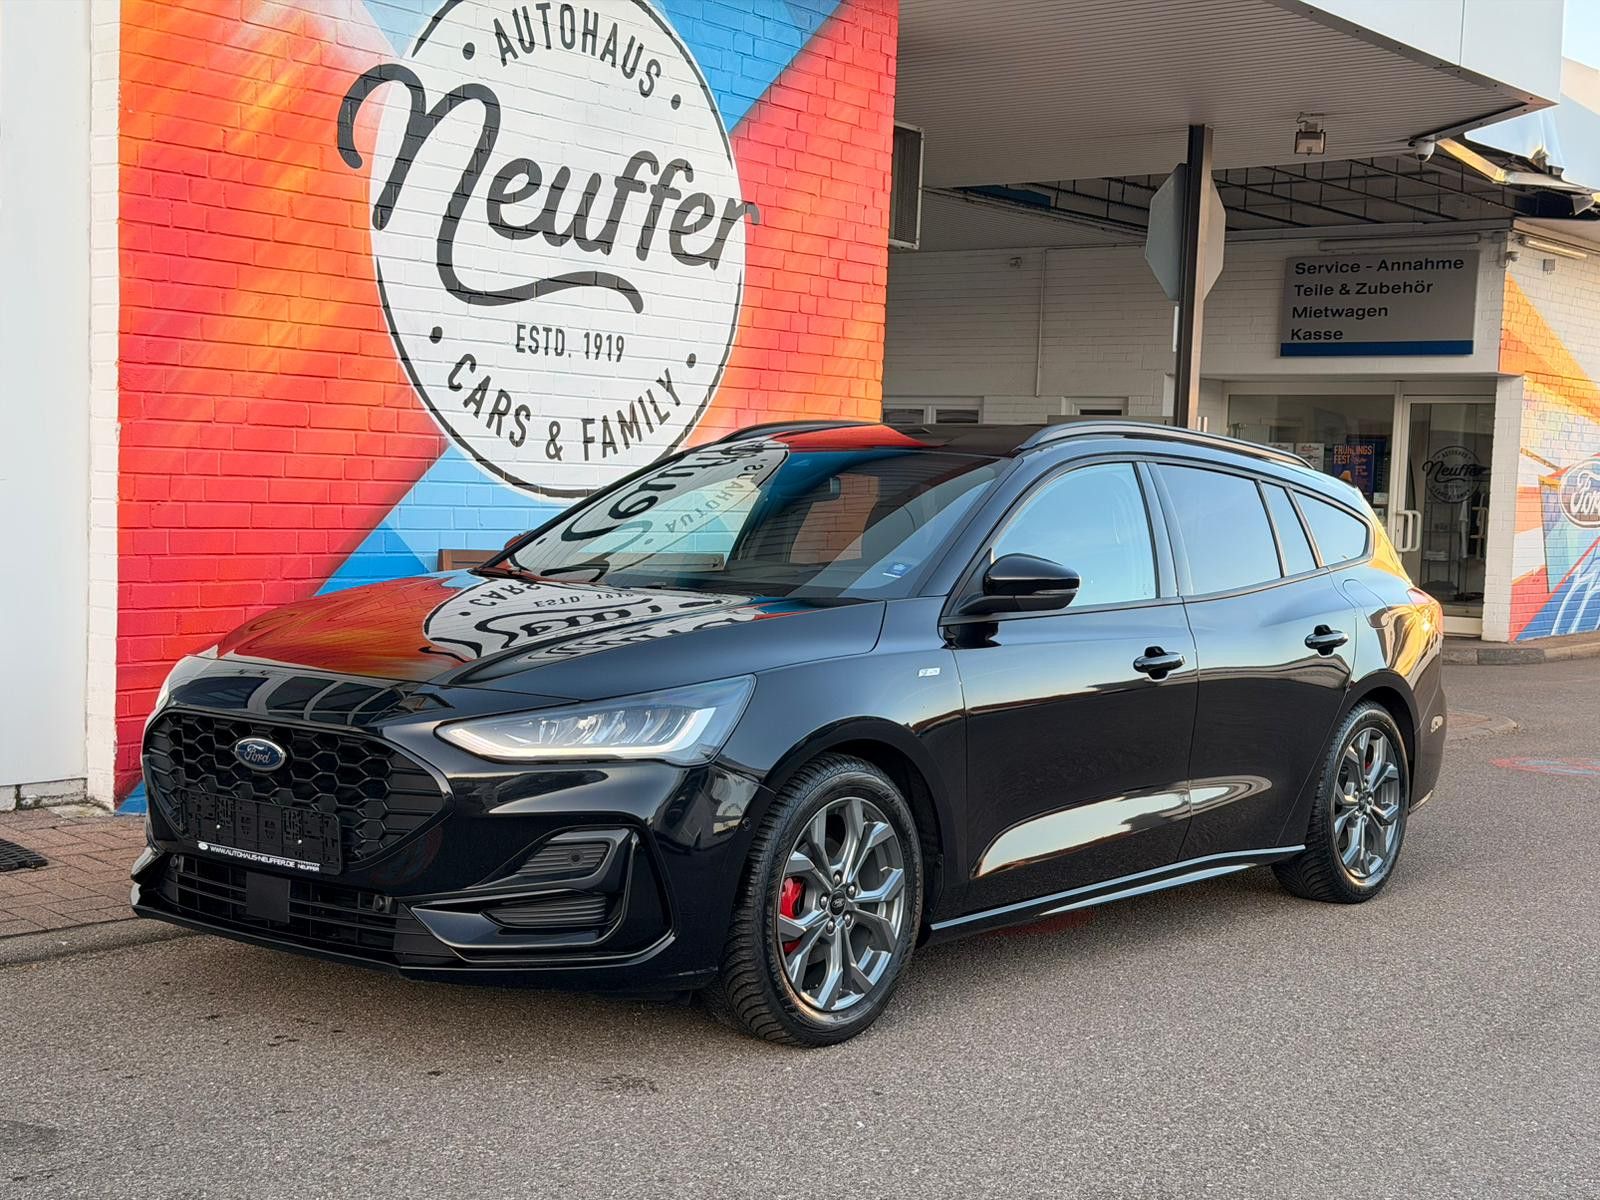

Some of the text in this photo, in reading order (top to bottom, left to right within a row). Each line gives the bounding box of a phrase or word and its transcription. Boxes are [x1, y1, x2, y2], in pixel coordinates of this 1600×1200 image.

[493, 3, 661, 98] AUTOHAUS
[337, 64, 760, 314] Neuffer
[1295, 262, 1361, 275] Service
[1376, 258, 1465, 272] Annahme
[1294, 280, 1434, 297] Teile & Zubehör
[1292, 306, 1389, 320] Mietwagen
[516, 324, 625, 363] ESTD. 1919
[1290, 329, 1344, 341] Kasse
[447, 353, 681, 462] CARS & FAMILY
[1334, 455, 1351, 464] FEST
[243, 743, 271, 763] Ford
